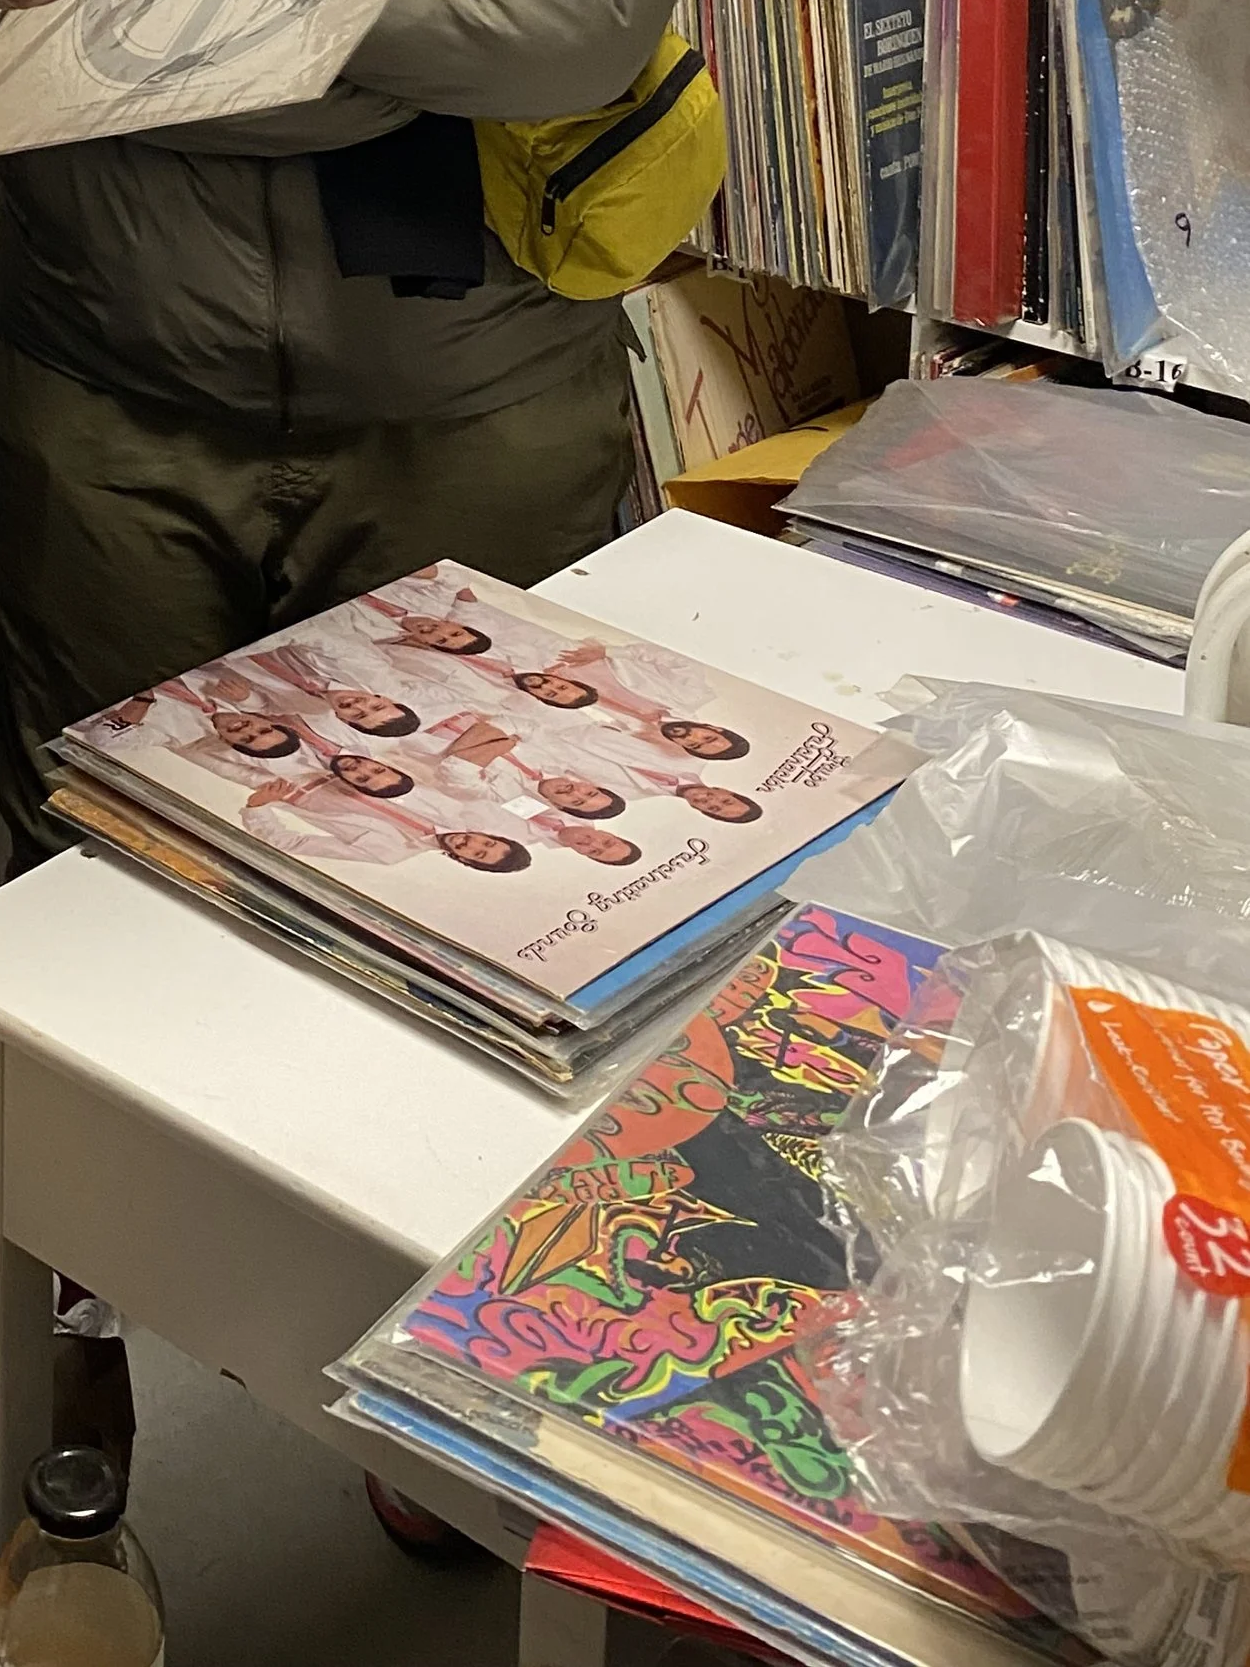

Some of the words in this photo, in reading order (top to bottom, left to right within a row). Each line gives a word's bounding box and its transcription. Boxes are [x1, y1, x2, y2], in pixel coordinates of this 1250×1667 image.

[1174, 211, 1193, 248] 9
[1124, 358, 1183, 382] B-16
[587, 837, 710, 914] Fascinating
[516, 909, 599, 962] Sounds
[1198, 1104, 1236, 1134] Hot
[1179, 1201, 1250, 1277] 32
